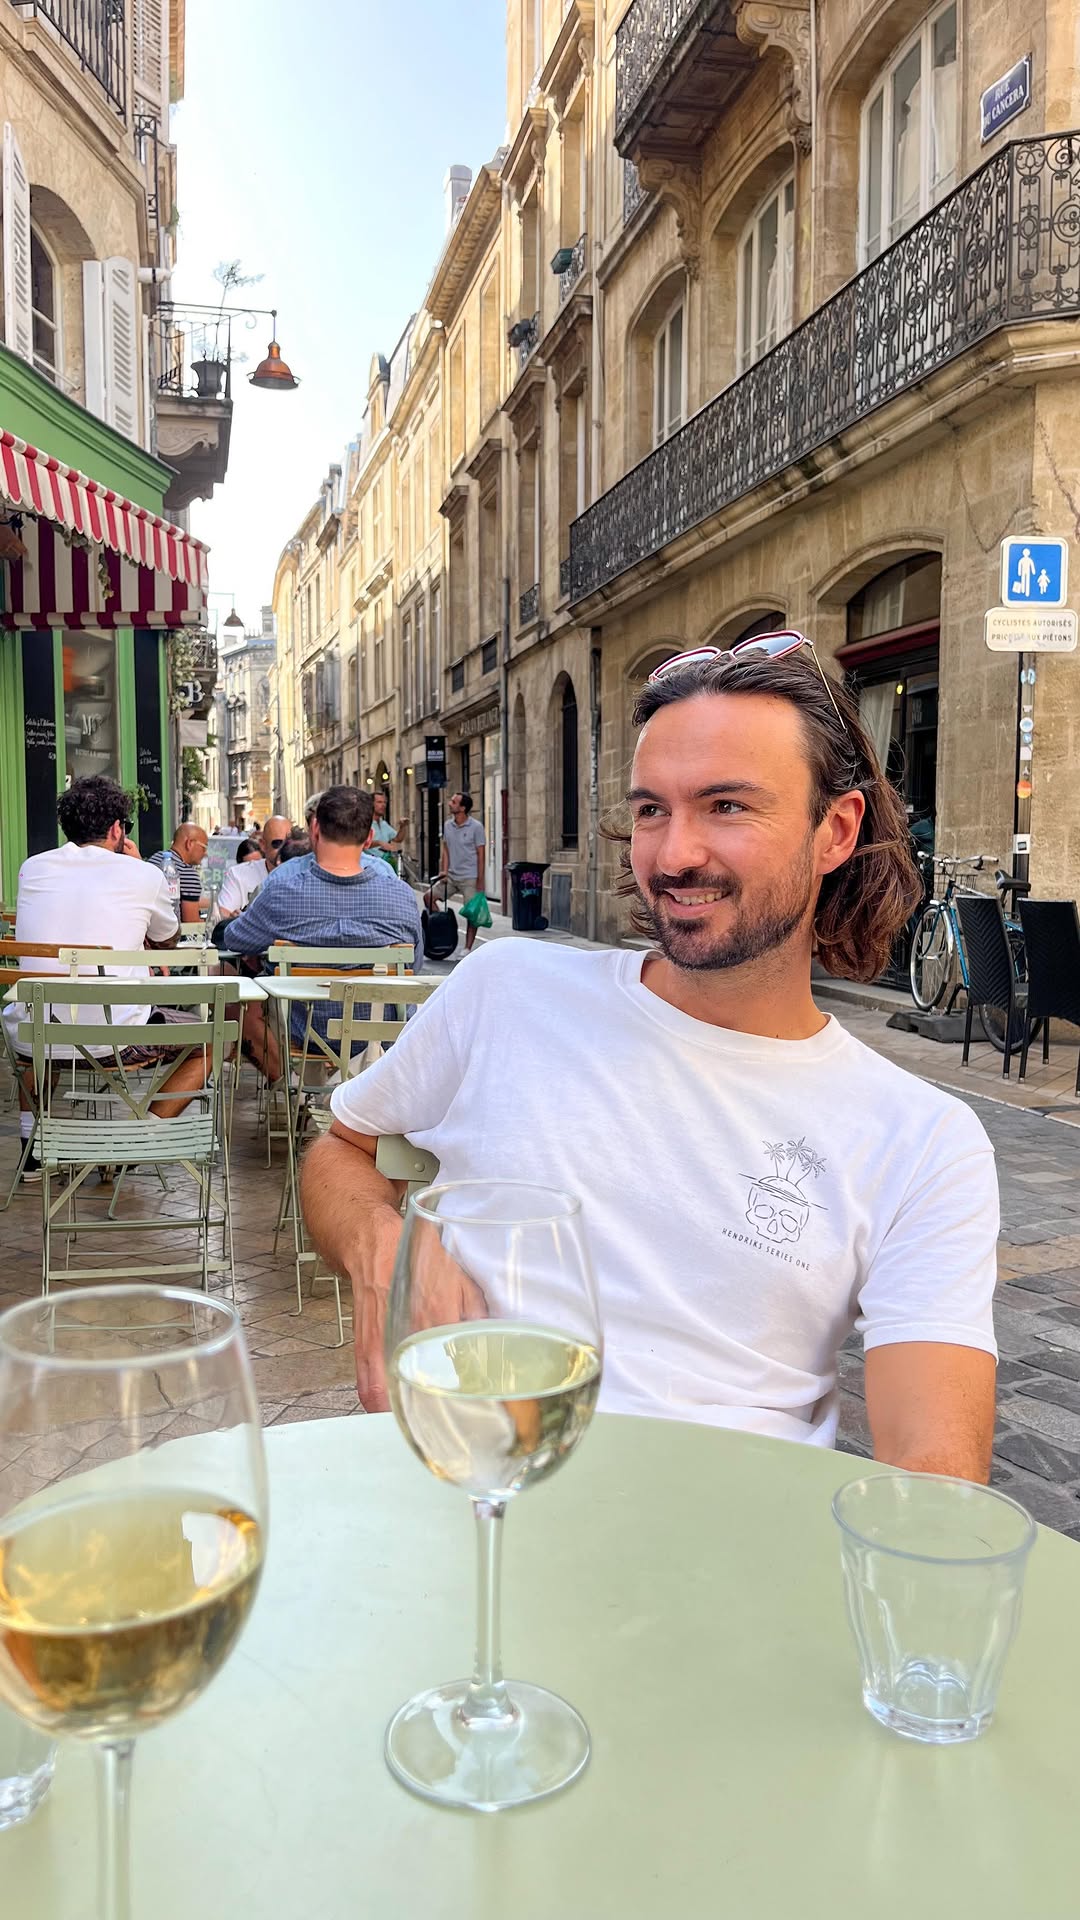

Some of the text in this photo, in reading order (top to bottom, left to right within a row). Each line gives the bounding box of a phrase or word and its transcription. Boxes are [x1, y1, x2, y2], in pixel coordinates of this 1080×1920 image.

[994, 79, 1010, 101] RUE
[991, 85, 1024, 119] CANCERA
[1033, 618, 1072, 627] AUTORISÉS
[1042, 633, 1072, 641] PIÉTONS
[721, 1227, 810, 1271] HENDRIKS SERIES ONE
